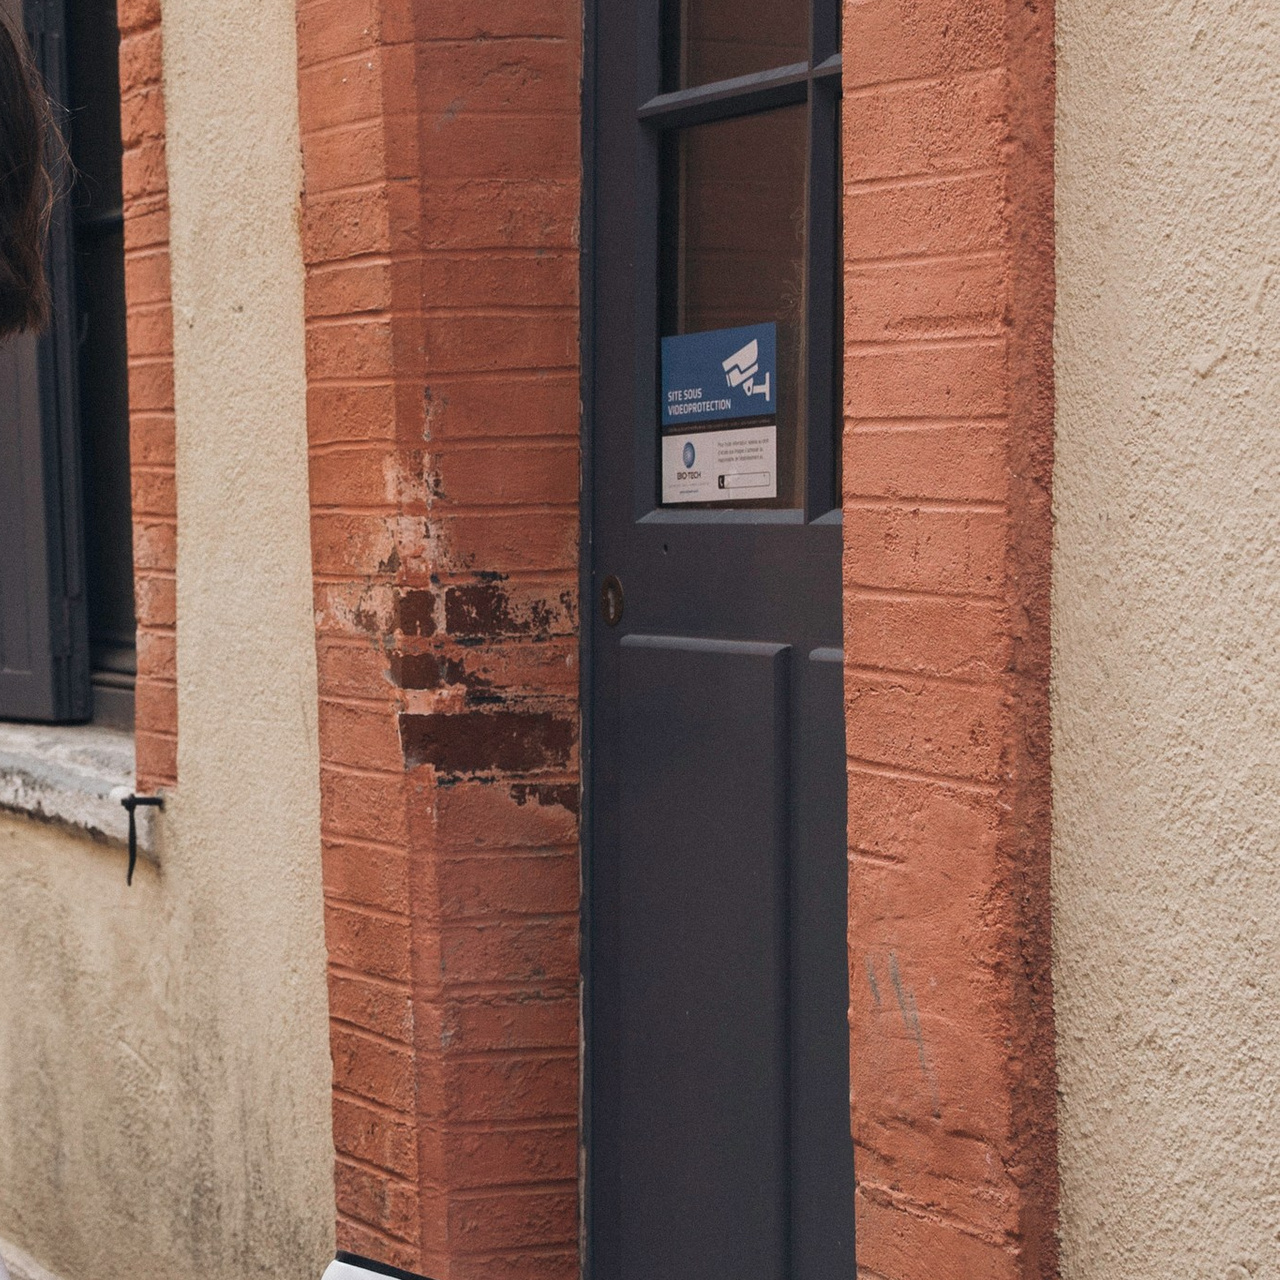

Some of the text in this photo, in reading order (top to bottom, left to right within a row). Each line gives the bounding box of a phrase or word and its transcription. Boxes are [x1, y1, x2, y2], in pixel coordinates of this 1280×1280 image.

[667, 388, 702, 402] SITE SOUS
[667, 398, 732, 416] VIDEOPROTECTION
